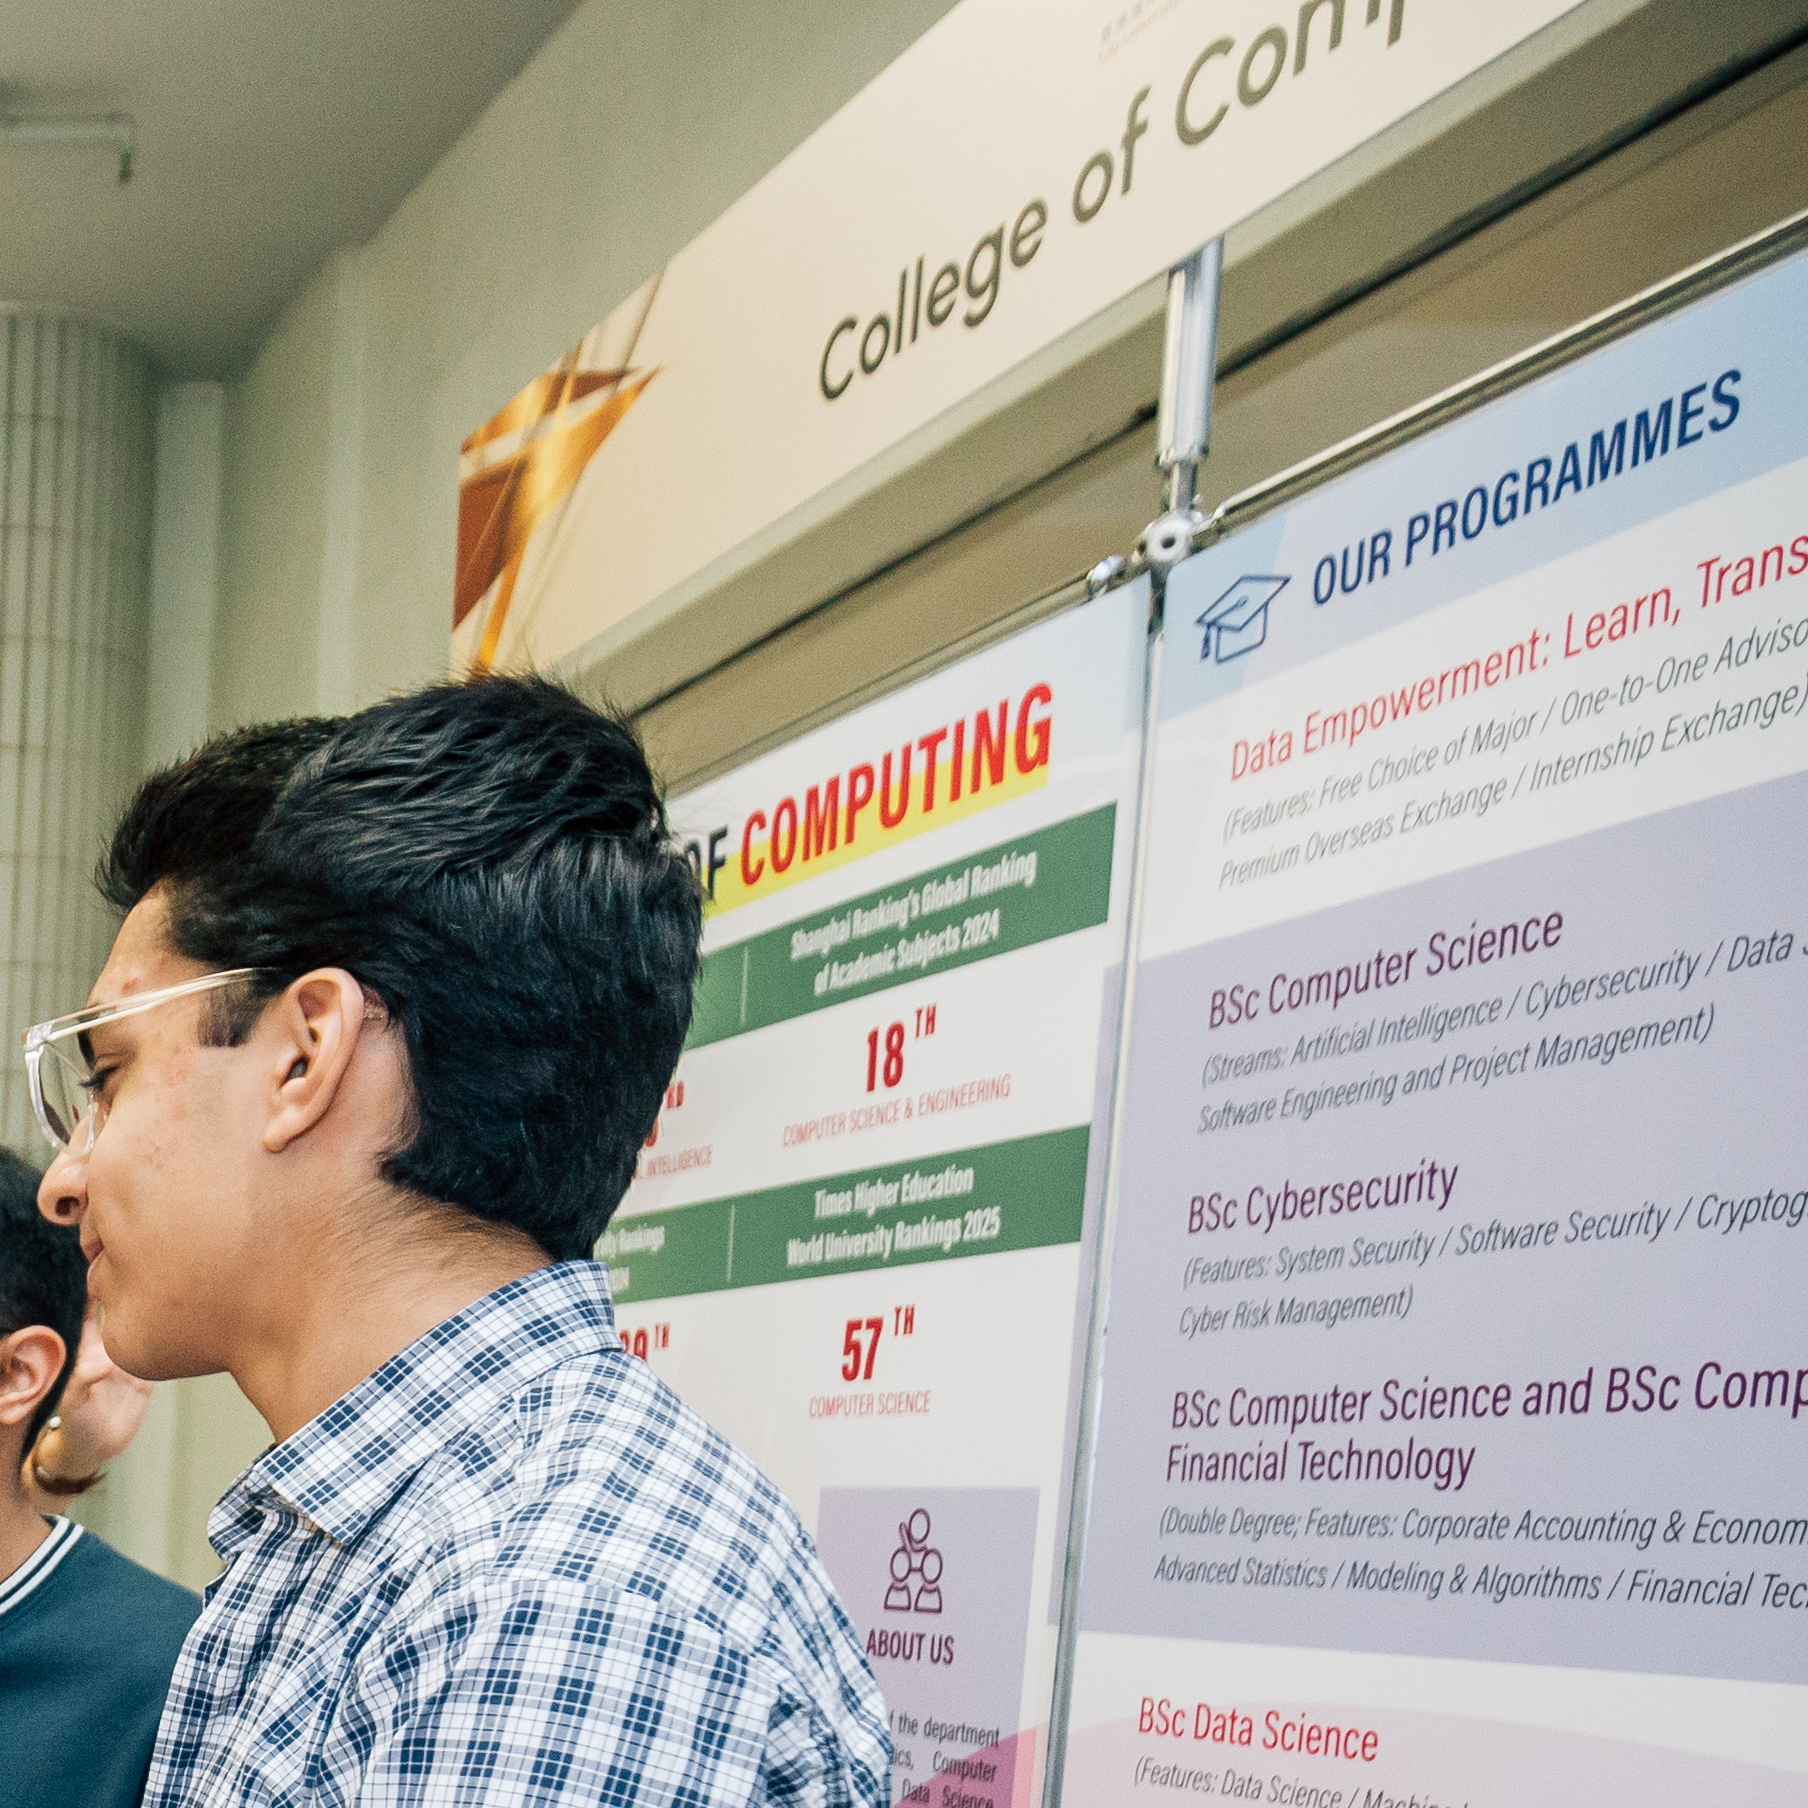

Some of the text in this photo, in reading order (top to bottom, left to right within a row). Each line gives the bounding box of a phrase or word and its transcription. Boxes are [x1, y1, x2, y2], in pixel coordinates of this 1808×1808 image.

[816, 195, 1050, 402] College
[1069, 87, 1152, 222] of
[1175, 0, 1405, 147] Com
[1313, 369, 1743, 604] OUR PROGRAMMES
[1232, 533, 1808, 782] Data Empowerment: Learn, Trans
[740, 681, 1053, 888] COMPUTING
[1318, 708, 1539, 809] Free Choice Major
[1219, 723, 1654, 890] Premium Overseas Exchange Internship
[791, 850, 1037, 962] Shanghai Ranking's Global Ranking
[814, 909, 999, 996] of Academic Subjects 2024
[1210, 911, 1564, 1030] BSc Computer Science
[1525, 929, 1794, 1022] Cybersecurity Data
[865, 1003, 937, 1094] 18 TH
[782, 1073, 1012, 1148] COMPUTER SCIENCE ENGINEERING
[1197, 1044, 1530, 1135] Software Engineering and Project
[814, 1164, 974, 1219] Times Higher Education
[1188, 1158, 1460, 1234] BSc Cybersecurity
[788, 1206, 1000, 1266] World University Rankings 2025
[1275, 1201, 1670, 1283] System Security Software Security
[842, 1304, 915, 1382] 57 TH
[1179, 1296, 1270, 1339] Cyber Risk
[809, 1390, 931, 1418] COMPUTER SCIENCE
[1171, 1389, 1220, 1431] BSc
[1229, 1384, 1371, 1433] Computer
[1380, 1376, 1512, 1422] Science
[1522, 1366, 1593, 1418] and
[1605, 1365, 1681, 1414] BSc
[1167, 1437, 1476, 1491] Financial Technology
[1402, 1509, 1656, 1550] Corporate Accounting
[1154, 1555, 1749, 1607] Advanced Statistics Modeling Algorithms Financial
[866, 1628, 954, 1665] ABOUT US
[924, 1716, 1000, 1750] department
[1139, 1696, 1380, 1762] BSc Data Science
[902, 1777, 930, 1805] Data
[933, 1751, 997, 1783] Computer
[1221, 1769, 1263, 1801] Data
